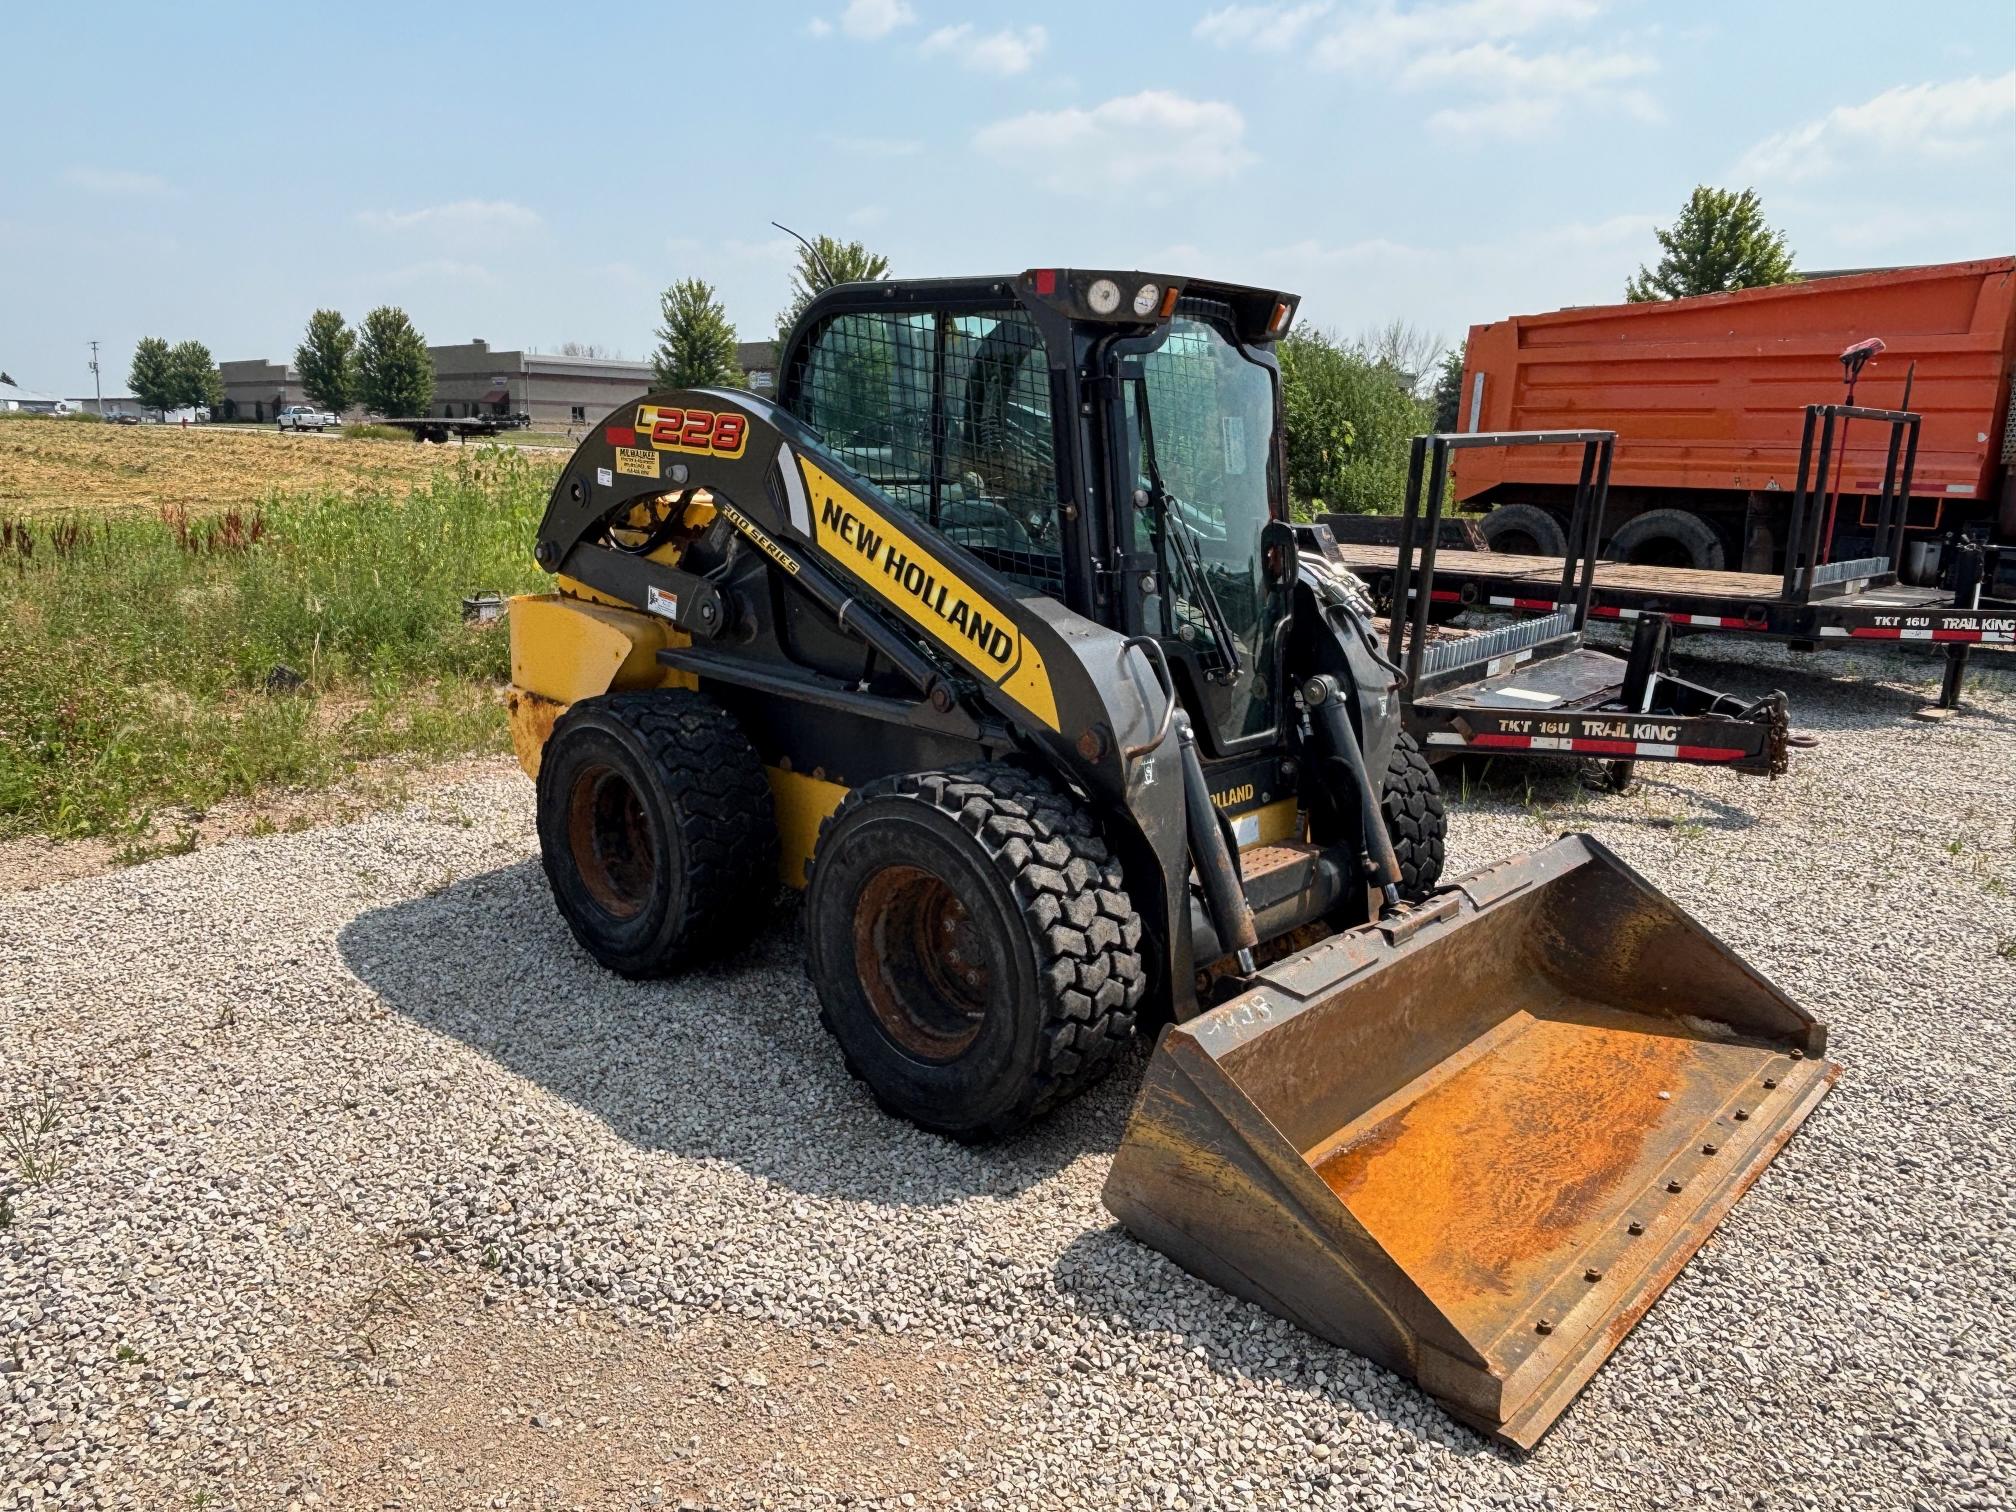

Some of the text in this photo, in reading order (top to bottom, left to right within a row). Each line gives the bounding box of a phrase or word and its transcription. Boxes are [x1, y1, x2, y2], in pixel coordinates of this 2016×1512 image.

[637, 407, 745, 453] L228
[751, 529, 799, 572] SERIES
[821, 497, 1013, 664] NEW HOLLAND
[1874, 616, 2016, 631] TKT 16U TRAIL KING
[1499, 719, 1677, 741] TKT 16U TRAIL KING
